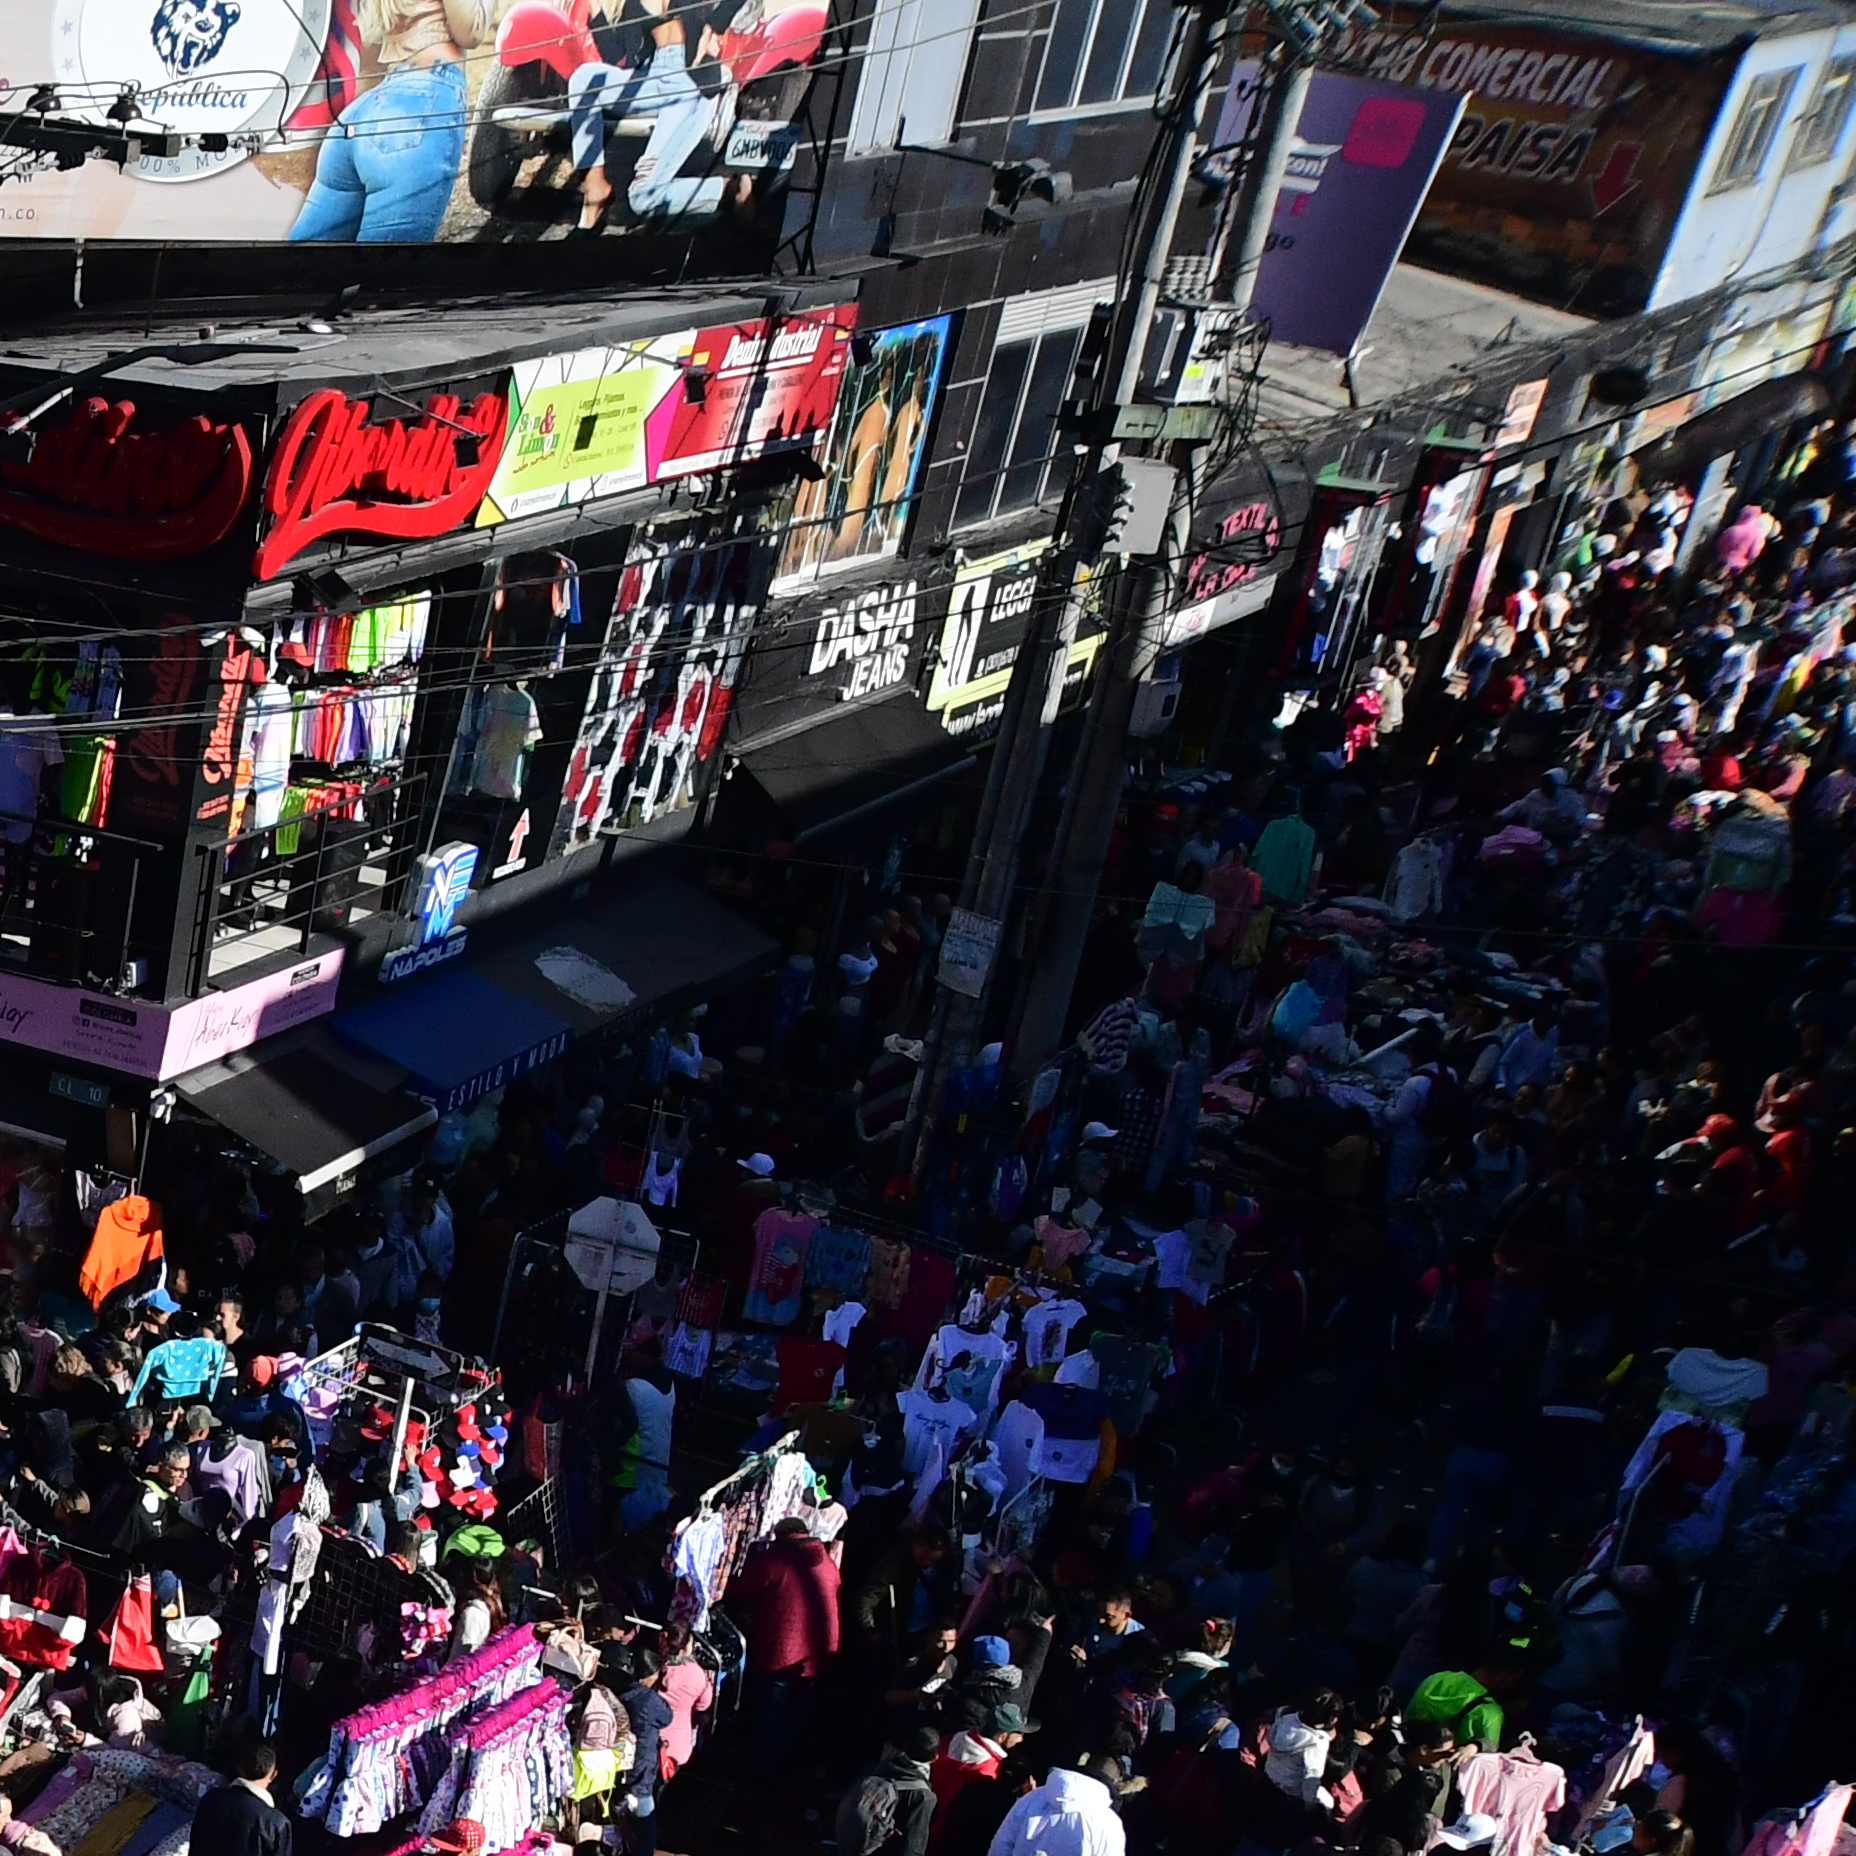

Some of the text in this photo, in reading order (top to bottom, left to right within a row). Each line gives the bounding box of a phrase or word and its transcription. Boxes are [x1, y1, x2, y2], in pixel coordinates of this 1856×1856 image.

[1418, 38, 1615, 110] COMERCIAL
[1443, 113, 1598, 184] PAISA
[808, 579, 918, 676] DASHA
[841, 642, 911, 703] JEANS
[389, 935, 468, 981] NAPOLES
[87, 1087, 104, 1102] 10
[447, 1032, 568, 1110] ESTILO Y MODA
